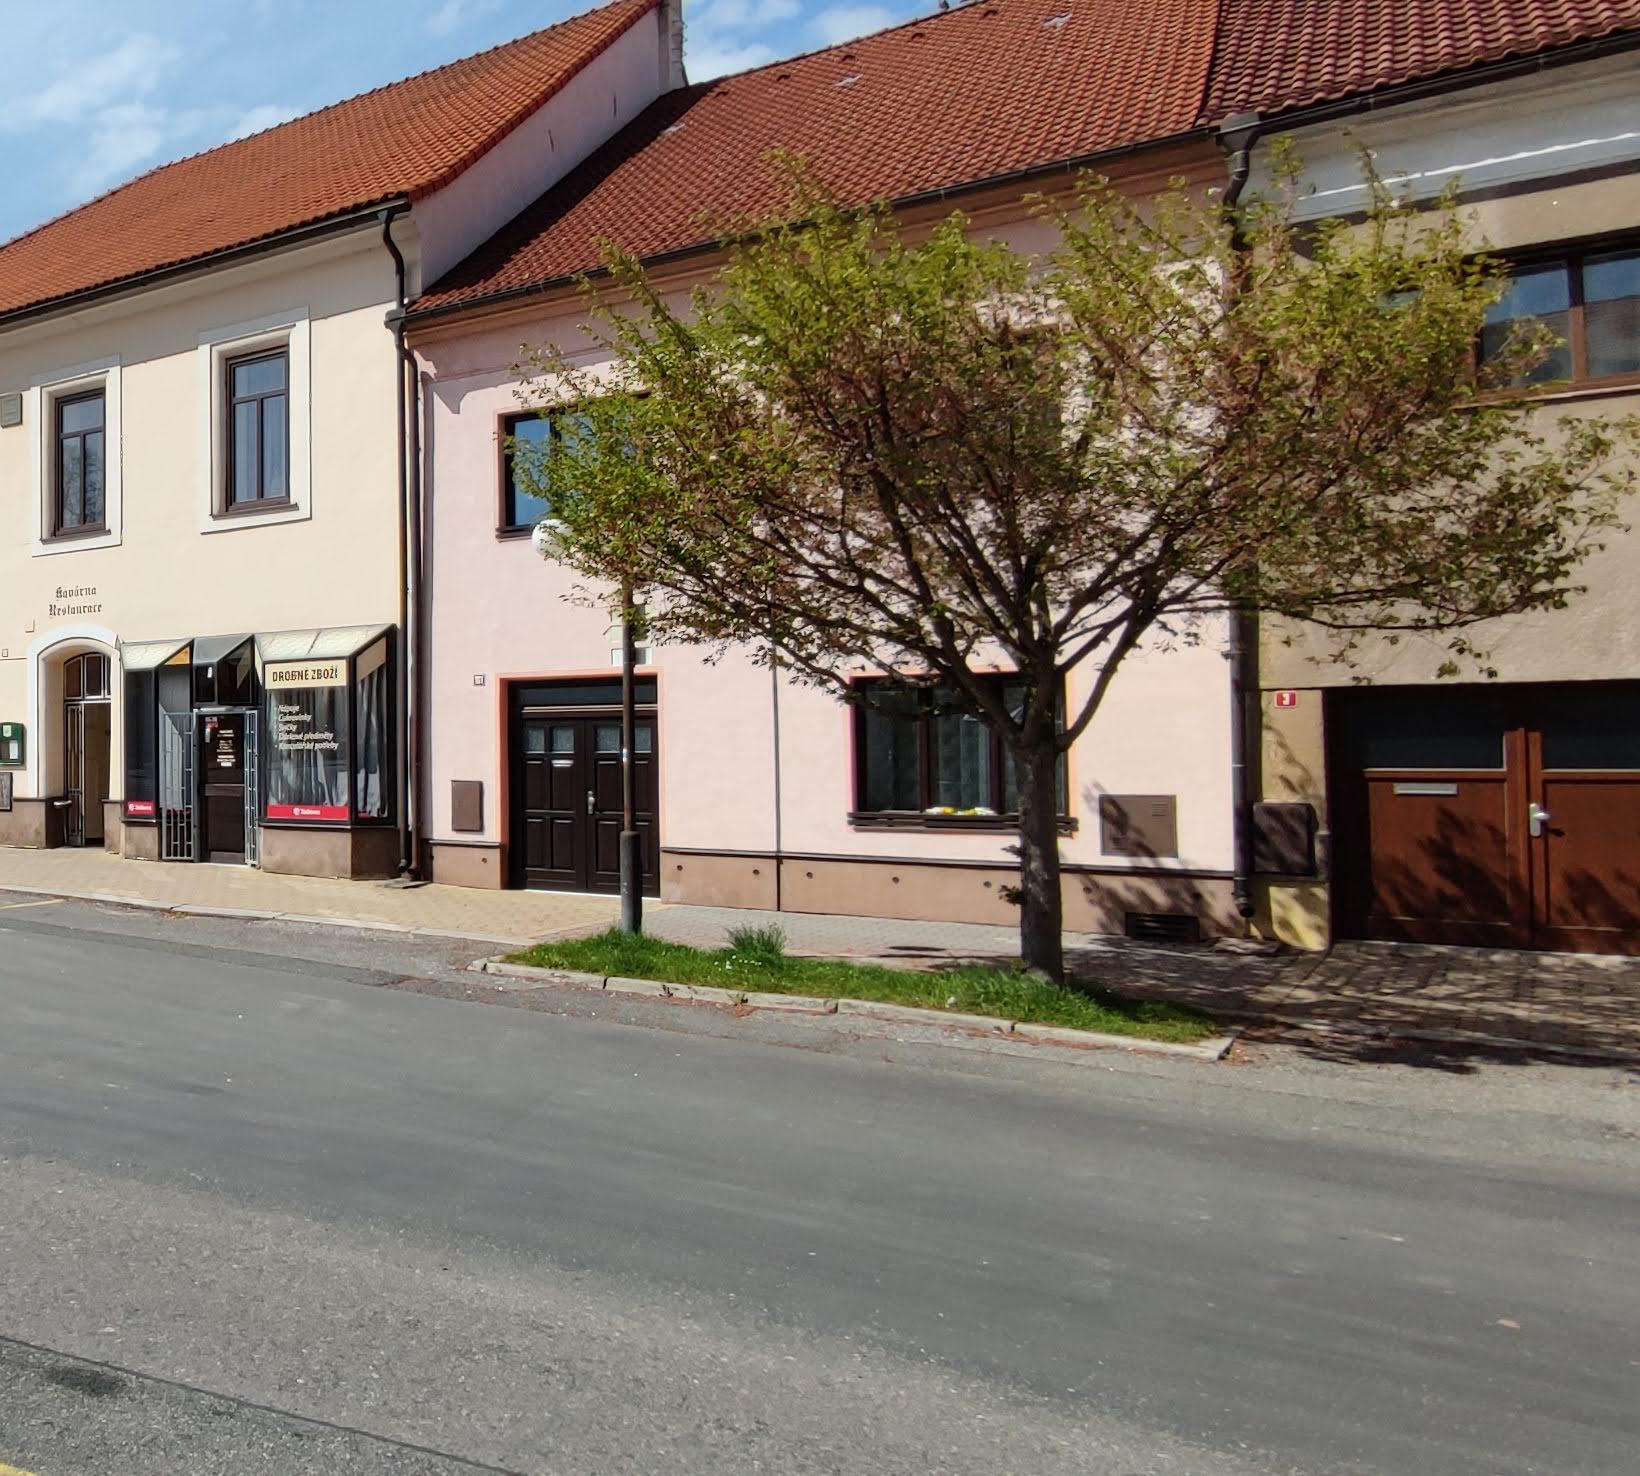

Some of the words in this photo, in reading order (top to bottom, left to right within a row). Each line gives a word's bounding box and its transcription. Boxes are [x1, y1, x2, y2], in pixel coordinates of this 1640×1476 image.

[272, 667, 309, 682] DROBNÉ
[311, 665, 338, 680] ZBOŽÍ
[1282, 693, 1290, 706] 3
